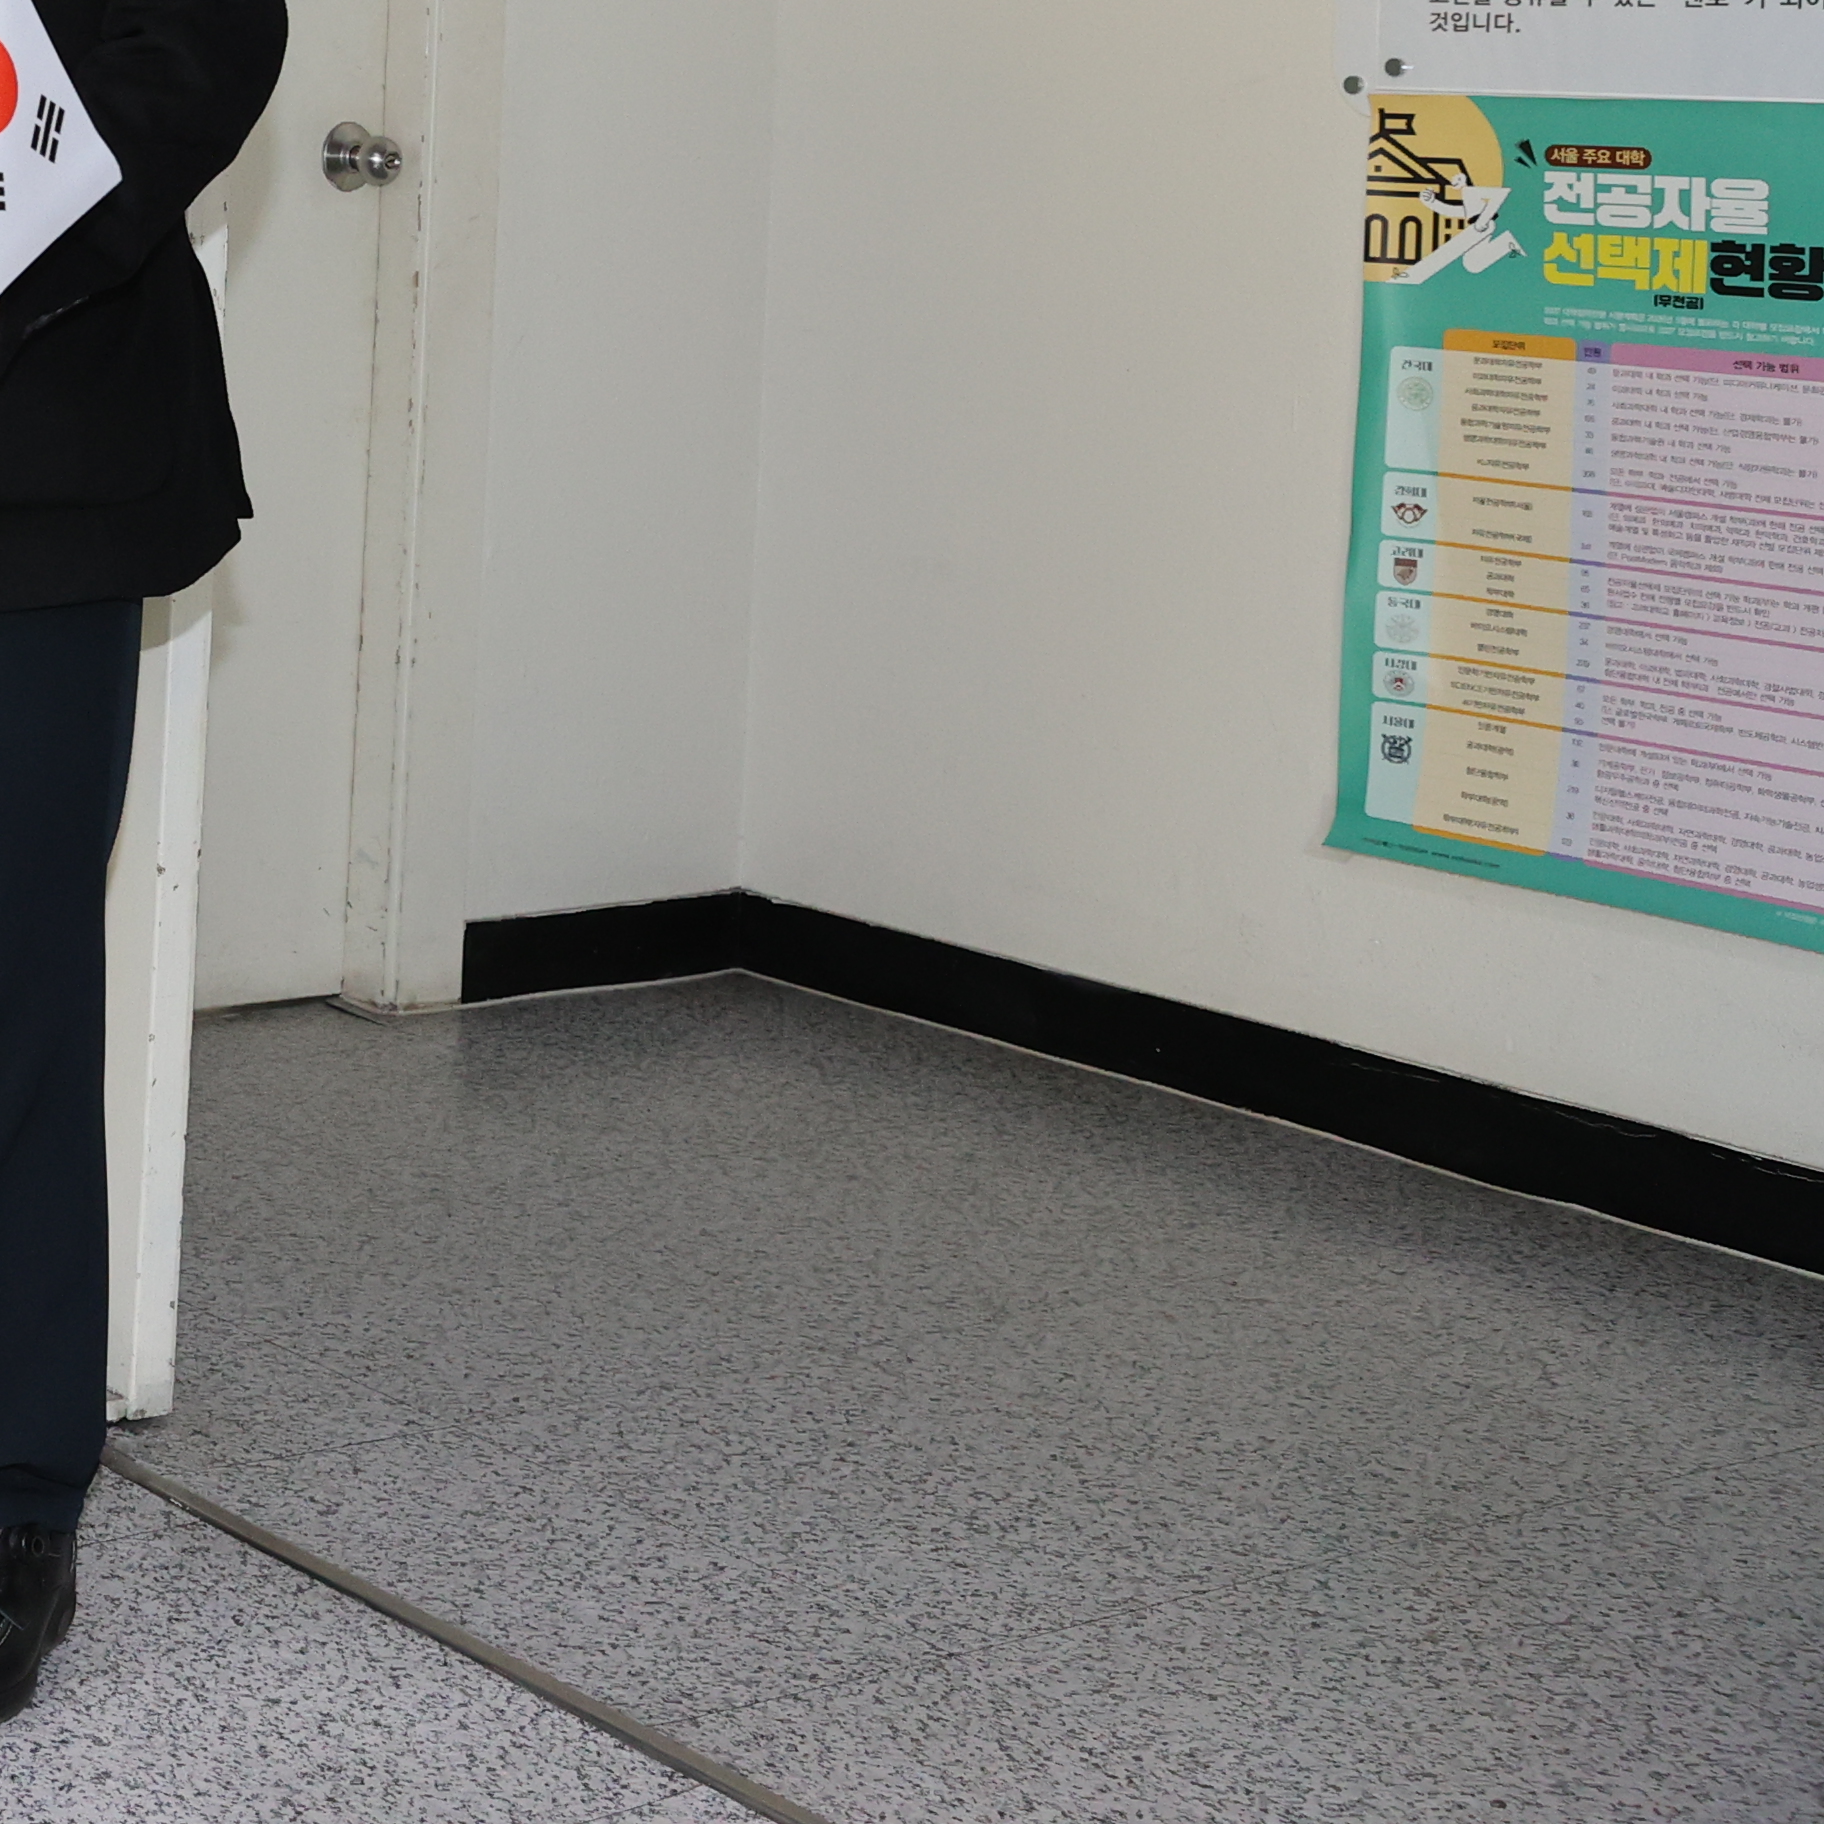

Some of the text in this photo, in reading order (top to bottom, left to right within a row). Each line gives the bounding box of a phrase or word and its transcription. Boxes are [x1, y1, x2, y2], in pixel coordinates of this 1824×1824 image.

[1429, 12, 1521, 34] 것입니다.
[1551, 147, 1646, 166] 서울 주요 대학
[1543, 170, 1769, 235] 전공자율
[1733, 360, 1752, 371] 선택
[1756, 361, 1775, 371] 가능
